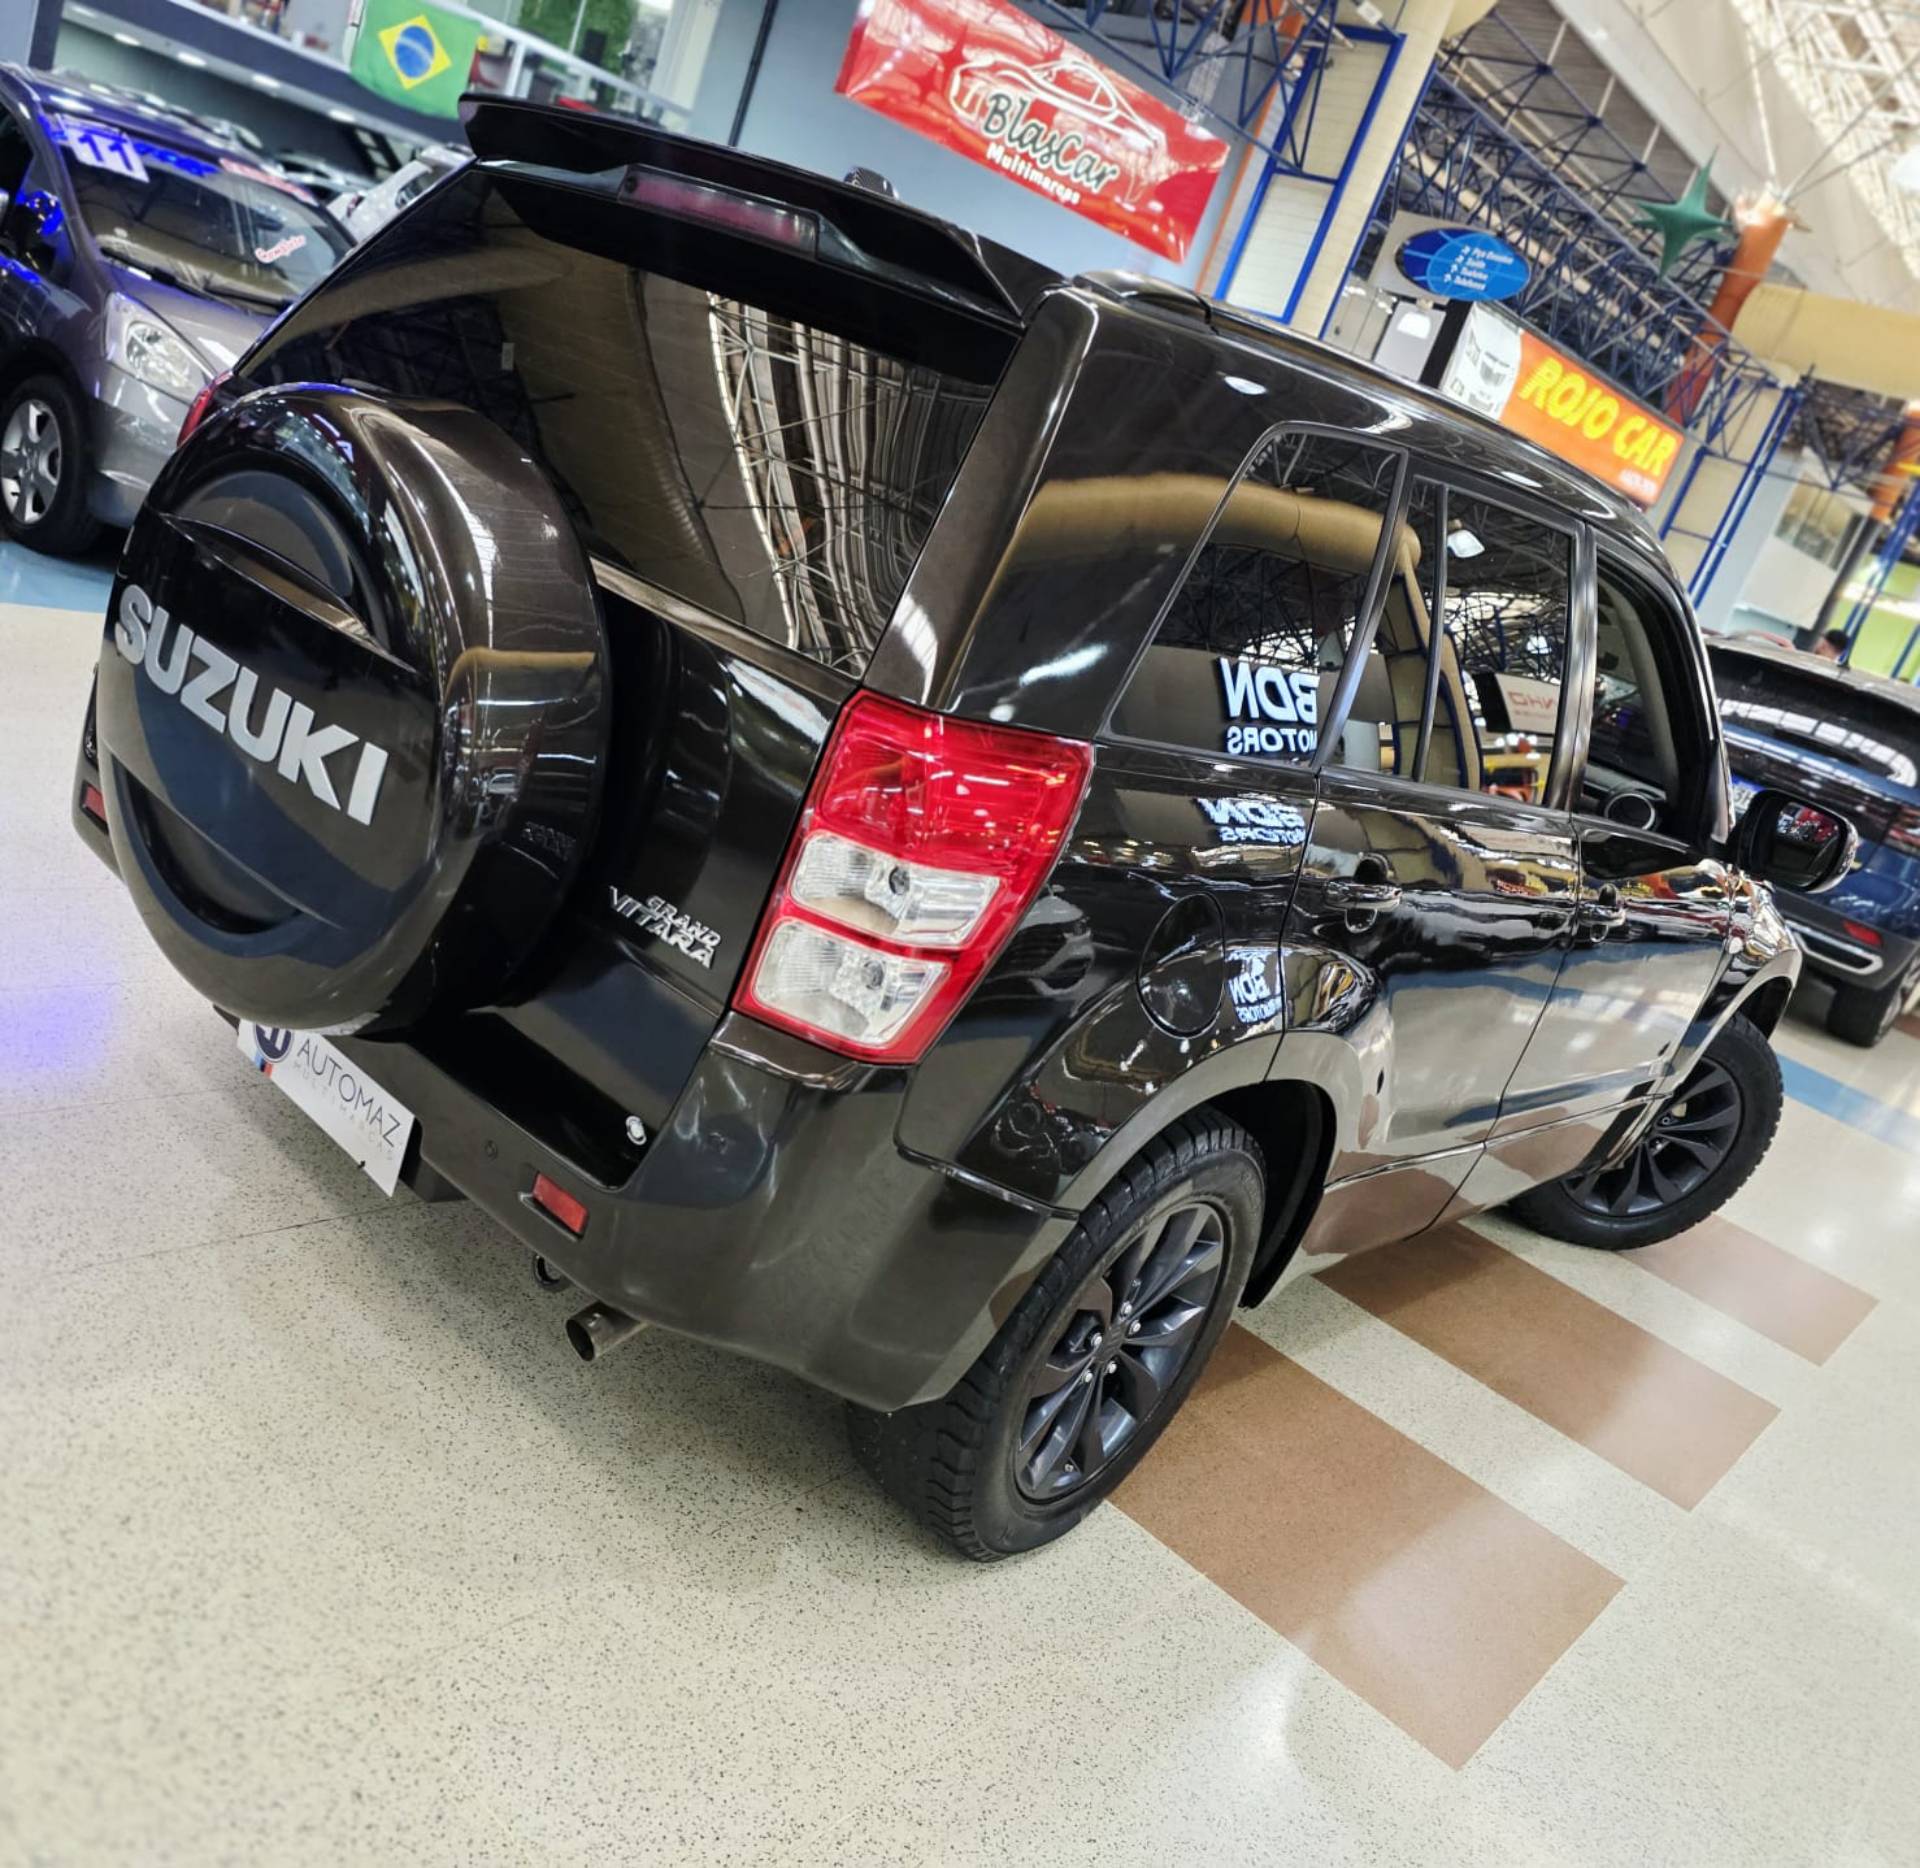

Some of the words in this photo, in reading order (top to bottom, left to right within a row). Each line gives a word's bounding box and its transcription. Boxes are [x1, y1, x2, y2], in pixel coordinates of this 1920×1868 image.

[982, 92, 1120, 194] BlasCar
[1517, 356, 1621, 440] ROJO
[1612, 415, 1678, 477] CAR
[114, 583, 389, 826] SUZUKI
[609, 885, 715, 969] VITARA
[646, 895, 721, 947] GRAND
[297, 1038, 401, 1147] AUTOMAZ
